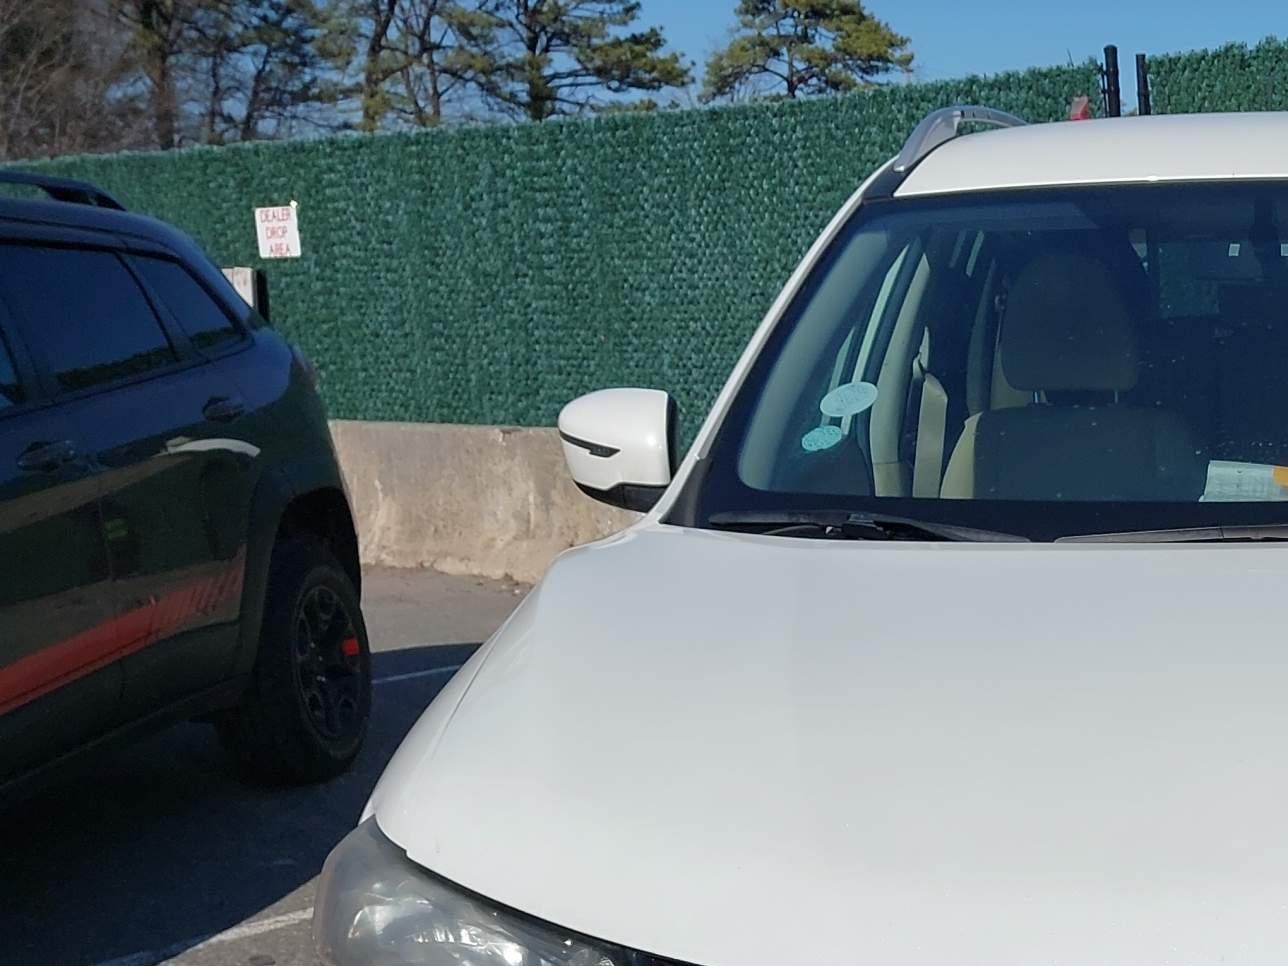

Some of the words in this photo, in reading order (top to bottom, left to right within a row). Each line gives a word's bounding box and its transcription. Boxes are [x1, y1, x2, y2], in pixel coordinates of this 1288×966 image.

[260, 207, 291, 223] DEALER
[265, 225, 288, 239] DROP
[269, 242, 291, 256] AREA
